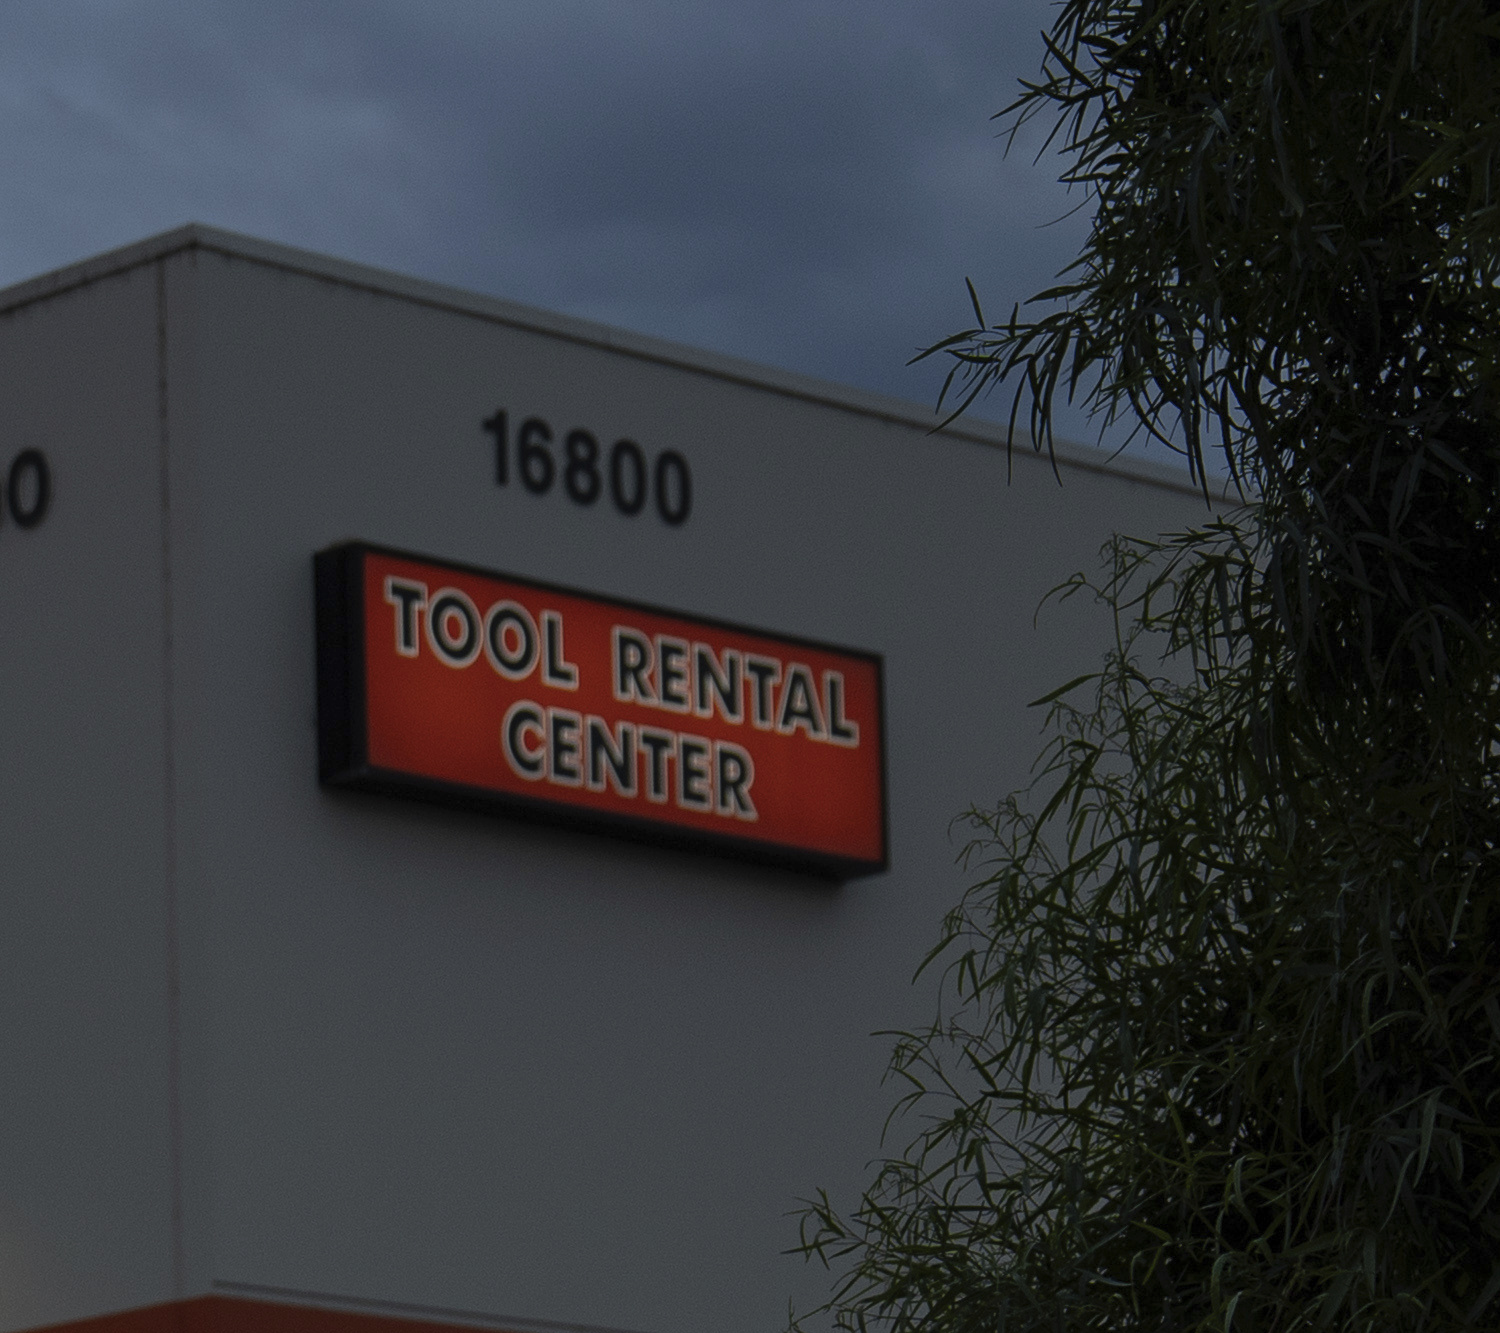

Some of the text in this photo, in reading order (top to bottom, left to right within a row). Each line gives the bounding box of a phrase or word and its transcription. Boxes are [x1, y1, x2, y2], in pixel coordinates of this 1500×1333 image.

[481, 407, 692, 526] 16800
[385, 574, 860, 748] TOOL RENTAL
[501, 700, 758, 822] CENTER
